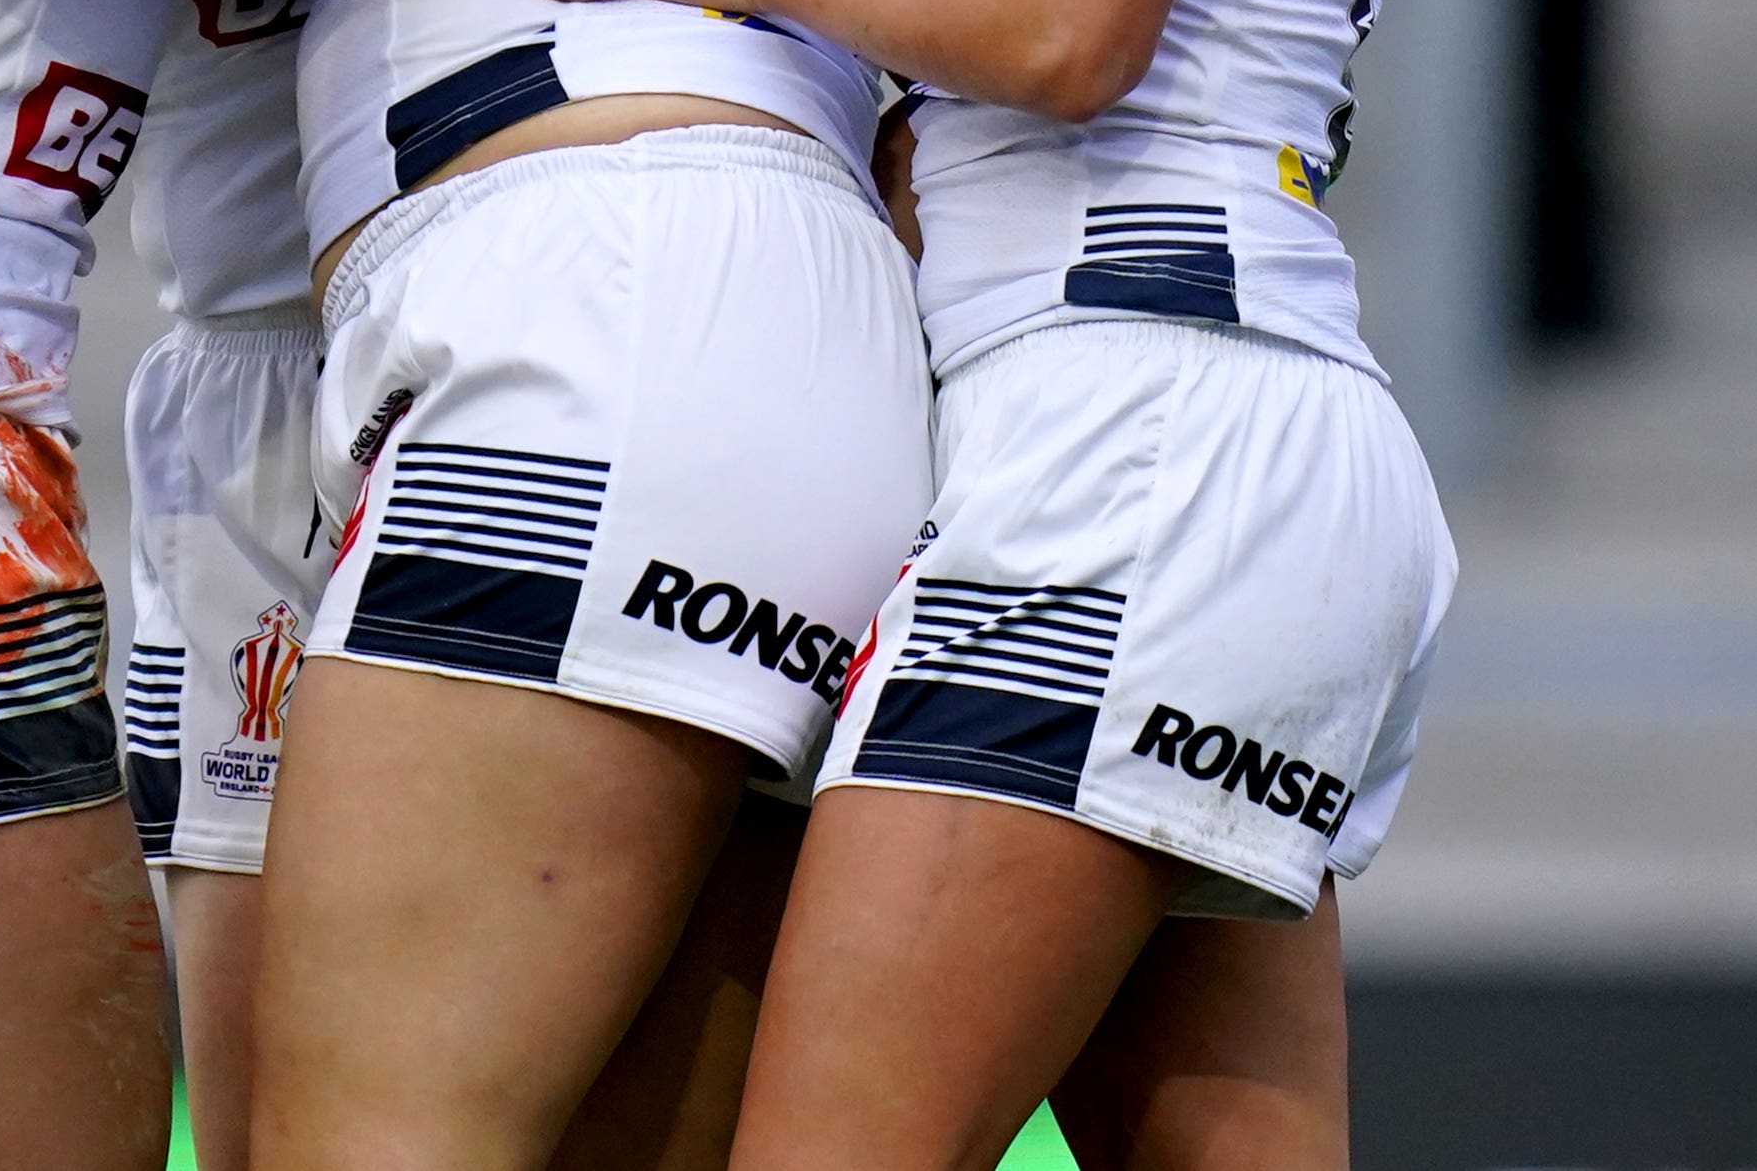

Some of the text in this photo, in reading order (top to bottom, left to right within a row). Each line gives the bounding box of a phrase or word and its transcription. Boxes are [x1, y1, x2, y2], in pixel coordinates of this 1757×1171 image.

[621, 559, 857, 721] RONSE
[206, 760, 270, 783] WORLD
[1131, 703, 1356, 846] RONSE
